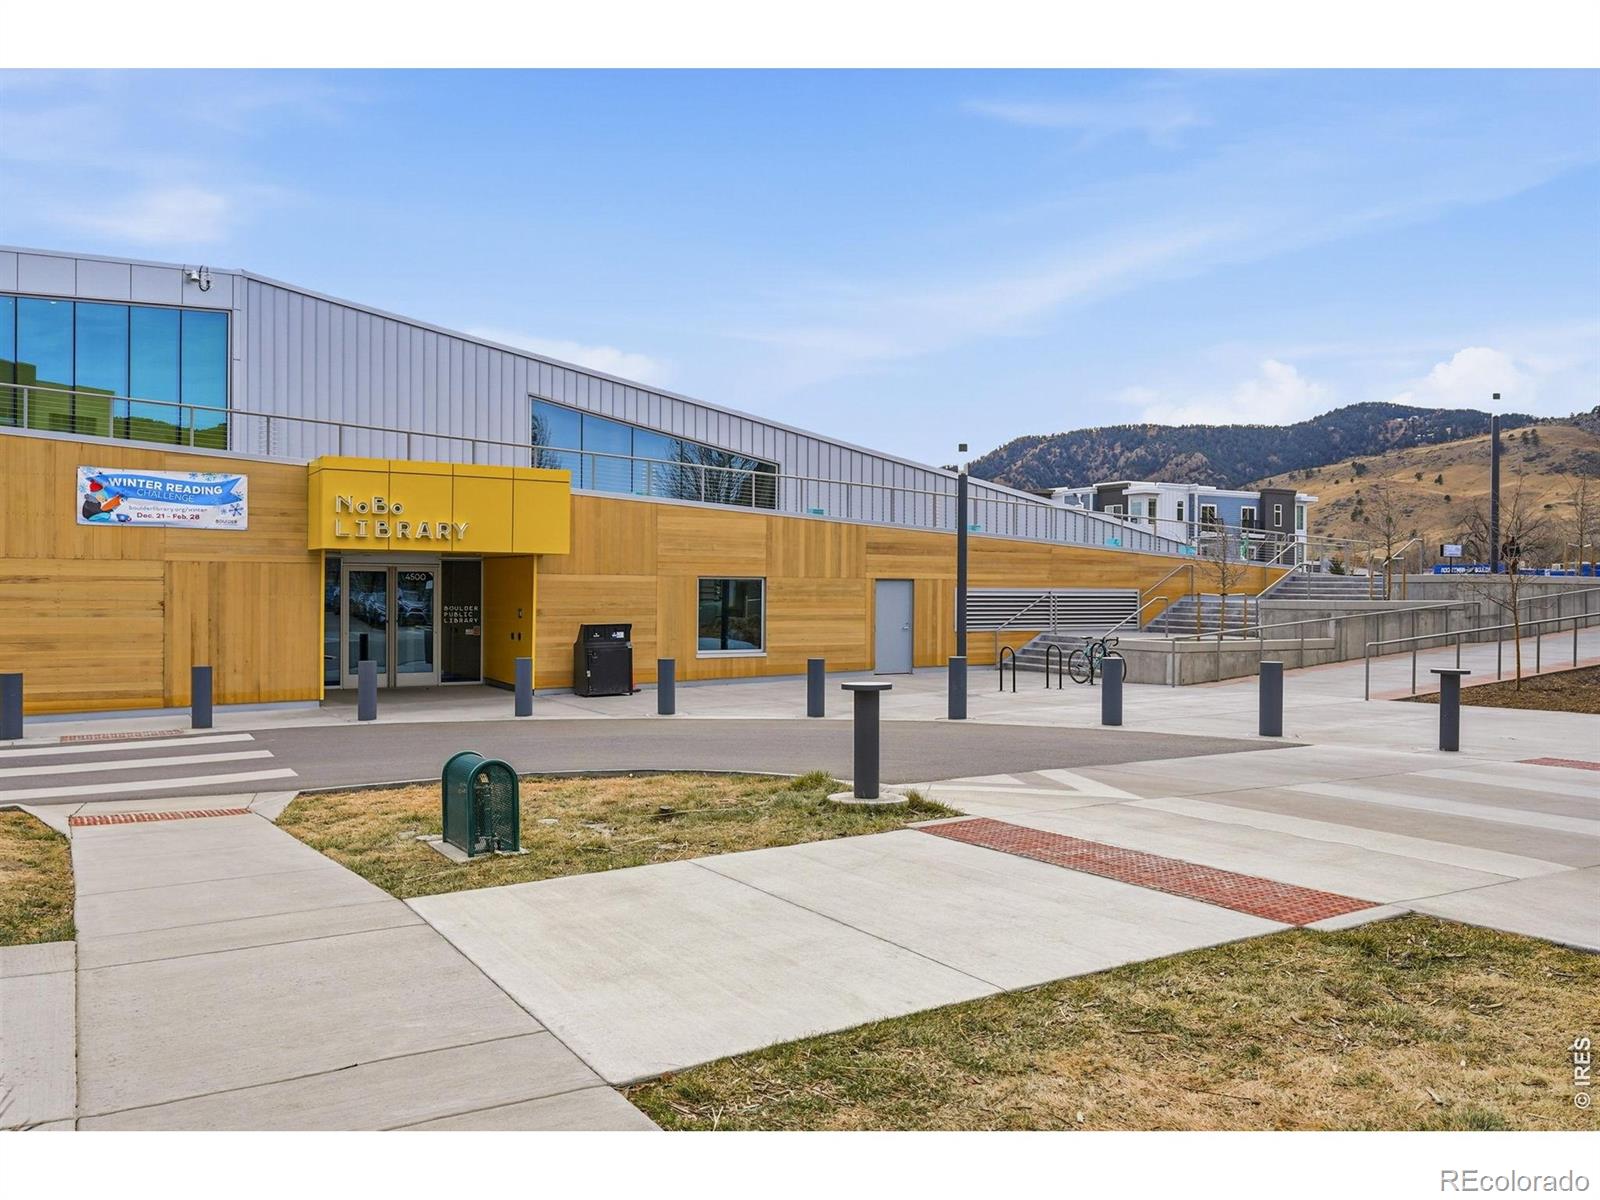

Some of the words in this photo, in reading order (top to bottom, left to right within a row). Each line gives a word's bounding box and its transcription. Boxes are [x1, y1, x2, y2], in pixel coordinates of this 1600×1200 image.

[108, 477, 162, 490] WINTER
[166, 482, 223, 495] READING
[136, 488, 195, 503] CHALLENGE
[335, 495, 404, 515] NoBo
[335, 518, 470, 540] LIBRARY
[405, 573, 427, 581] 4500
